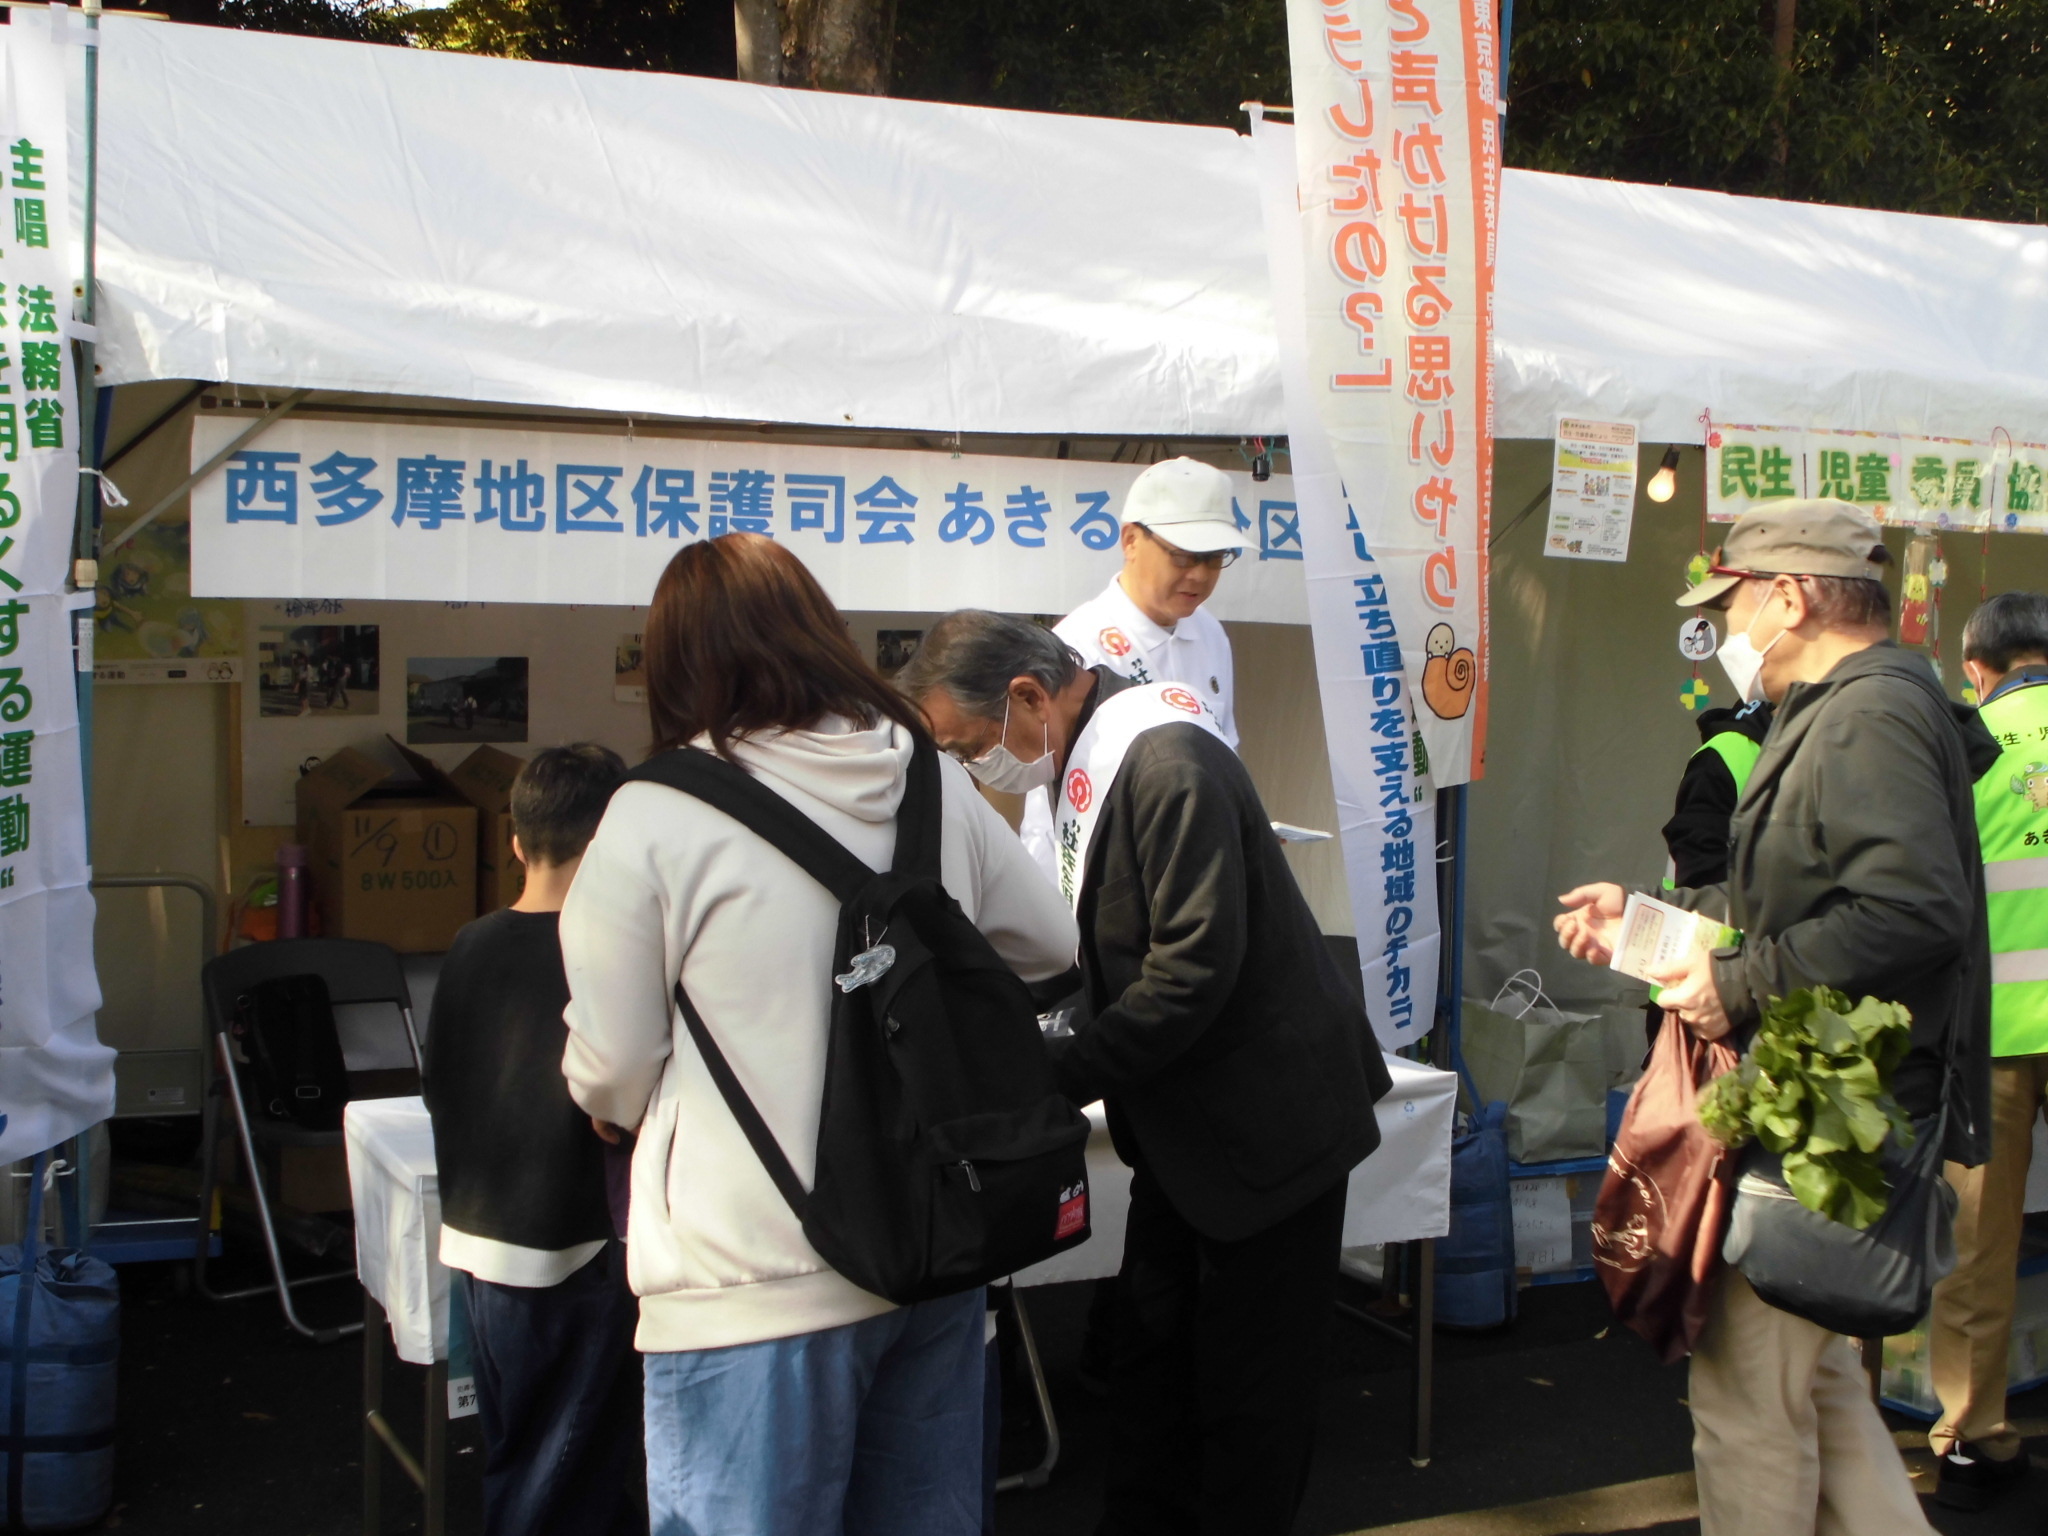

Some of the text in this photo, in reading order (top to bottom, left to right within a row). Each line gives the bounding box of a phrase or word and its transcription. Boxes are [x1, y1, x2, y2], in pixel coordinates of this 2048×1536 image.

[10, 138, 65, 448] 主唱 法務省
[226, 450, 919, 545] 西多摩地区保護司会
[938, 481, 1303, 561] あきる区
[1354, 574, 1415, 1030] 立ち直りを支える地域のチカラ
